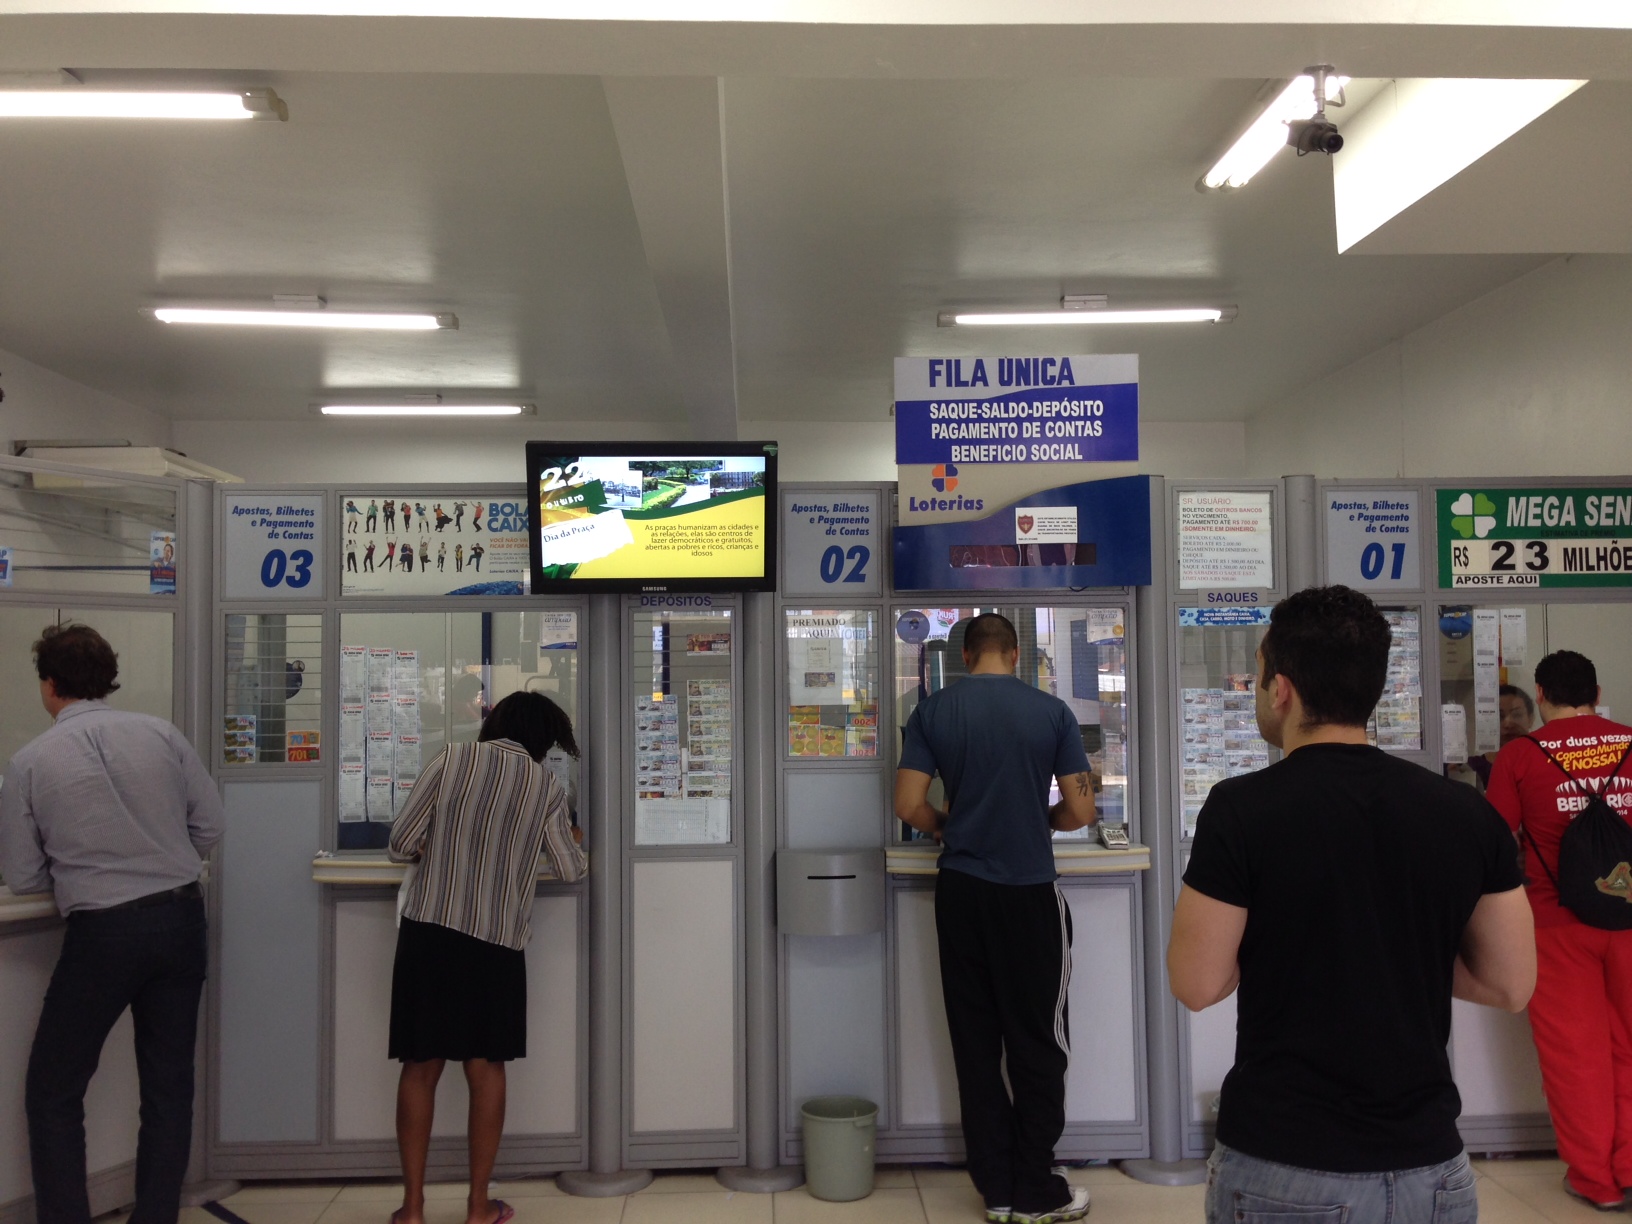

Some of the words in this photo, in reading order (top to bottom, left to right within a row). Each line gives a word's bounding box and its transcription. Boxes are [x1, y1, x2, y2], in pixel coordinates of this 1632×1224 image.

[929, 358, 989, 388] FILA
[929, 397, 1104, 420] SAQUE-SALDO-DEPÓSITO
[931, 421, 1018, 440] PAGAMENTO
[1022, 421, 1041, 438] DE
[1045, 420, 1103, 438] CONTAS
[951, 444, 1027, 462] BENEFICIO
[1030, 443, 1083, 461] SOCIAL
[541, 461, 585, 493] 22
[791, 503, 830, 514] Apostas,
[832, 503, 870, 512] Bilhetes
[909, 494, 984, 512] Loterias
[1331, 500, 1369, 513] Apostas,
[1372, 500, 1410, 511] Bilhetes
[232, 505, 273, 518] Apostas,
[275, 505, 315, 517] Bilhetes
[1506, 495, 1577, 527] MEGA
[1584, 495, 1632, 527] SEN
[251, 520, 257, 528] e
[259, 518, 315, 531] Pagamento
[817, 515, 870, 526] Pagamento
[1357, 512, 1410, 525] Pagamento
[267, 530, 280, 540] de
[282, 530, 315, 540] Contas
[543, 534, 559, 543] Dia
[560, 529, 571, 538] da
[571, 523, 595, 535] Praça
[825, 526, 837, 536] de
[839, 527, 870, 536] Contas
[1365, 524, 1377, 533] de
[1379, 524, 1410, 534] Contas
[1360, 542, 1406, 580] 01
[1453, 545, 1470, 569] R$
[260, 548, 314, 589] 03
[820, 544, 871, 584] 02
[1455, 575, 1504, 585] APOSTE
[1507, 575, 1538, 585] AQUI
[640, 594, 712, 607] DEPÓSITOS
[1207, 592, 1259, 603] SAQUES
[793, 618, 846, 627] PREMIADO
[1539, 740, 1562, 749] Por
[1566, 736, 1598, 747] duas
[290, 750, 307, 761] 701
[1556, 750, 1582, 762] Copa
[1583, 747, 1597, 757] do
[1572, 750, 1622, 771] NOSSA!
